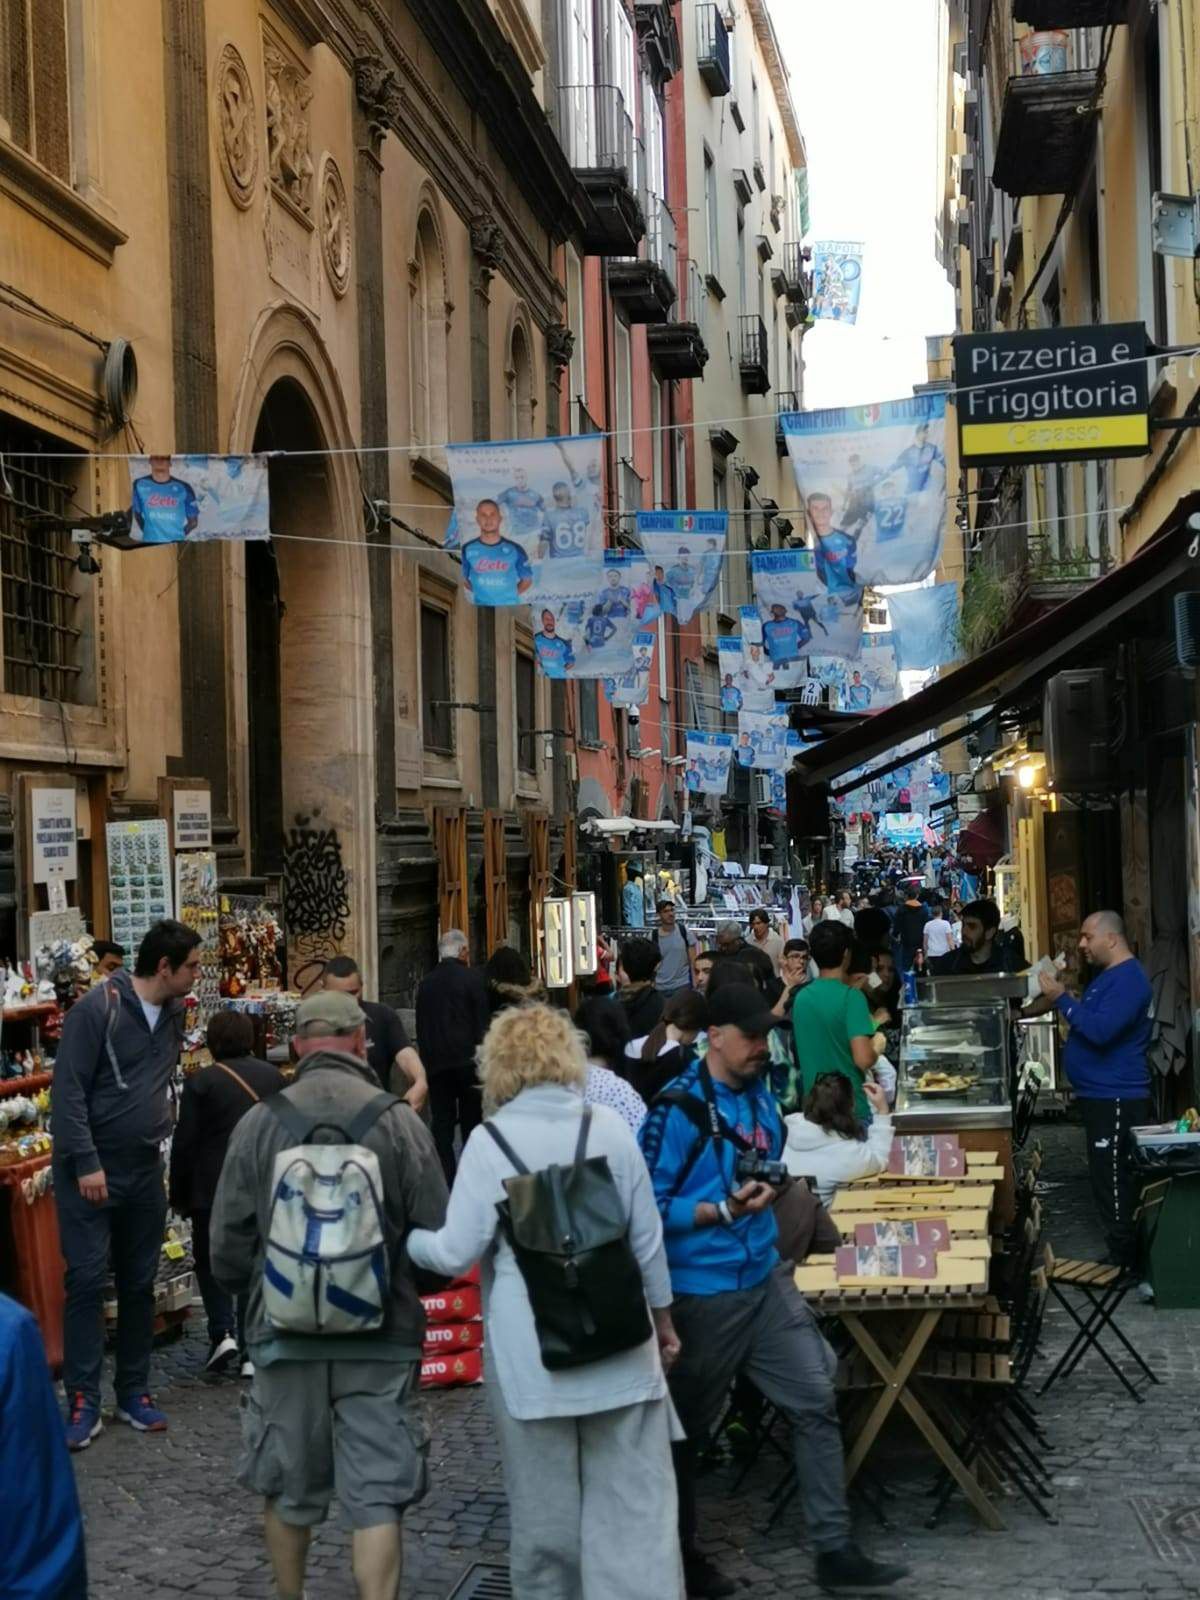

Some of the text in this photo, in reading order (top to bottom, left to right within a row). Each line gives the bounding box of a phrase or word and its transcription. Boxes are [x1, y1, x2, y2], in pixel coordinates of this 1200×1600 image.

[972, 341, 1130, 373] Pizzeria e
[969, 380, 1137, 419] Friggitoria
[1008, 425, 1102, 448] Capasso
[880, 506, 905, 528] 22
[555, 521, 586, 550] 68
[756, 554, 797, 570] CAMPIONI
